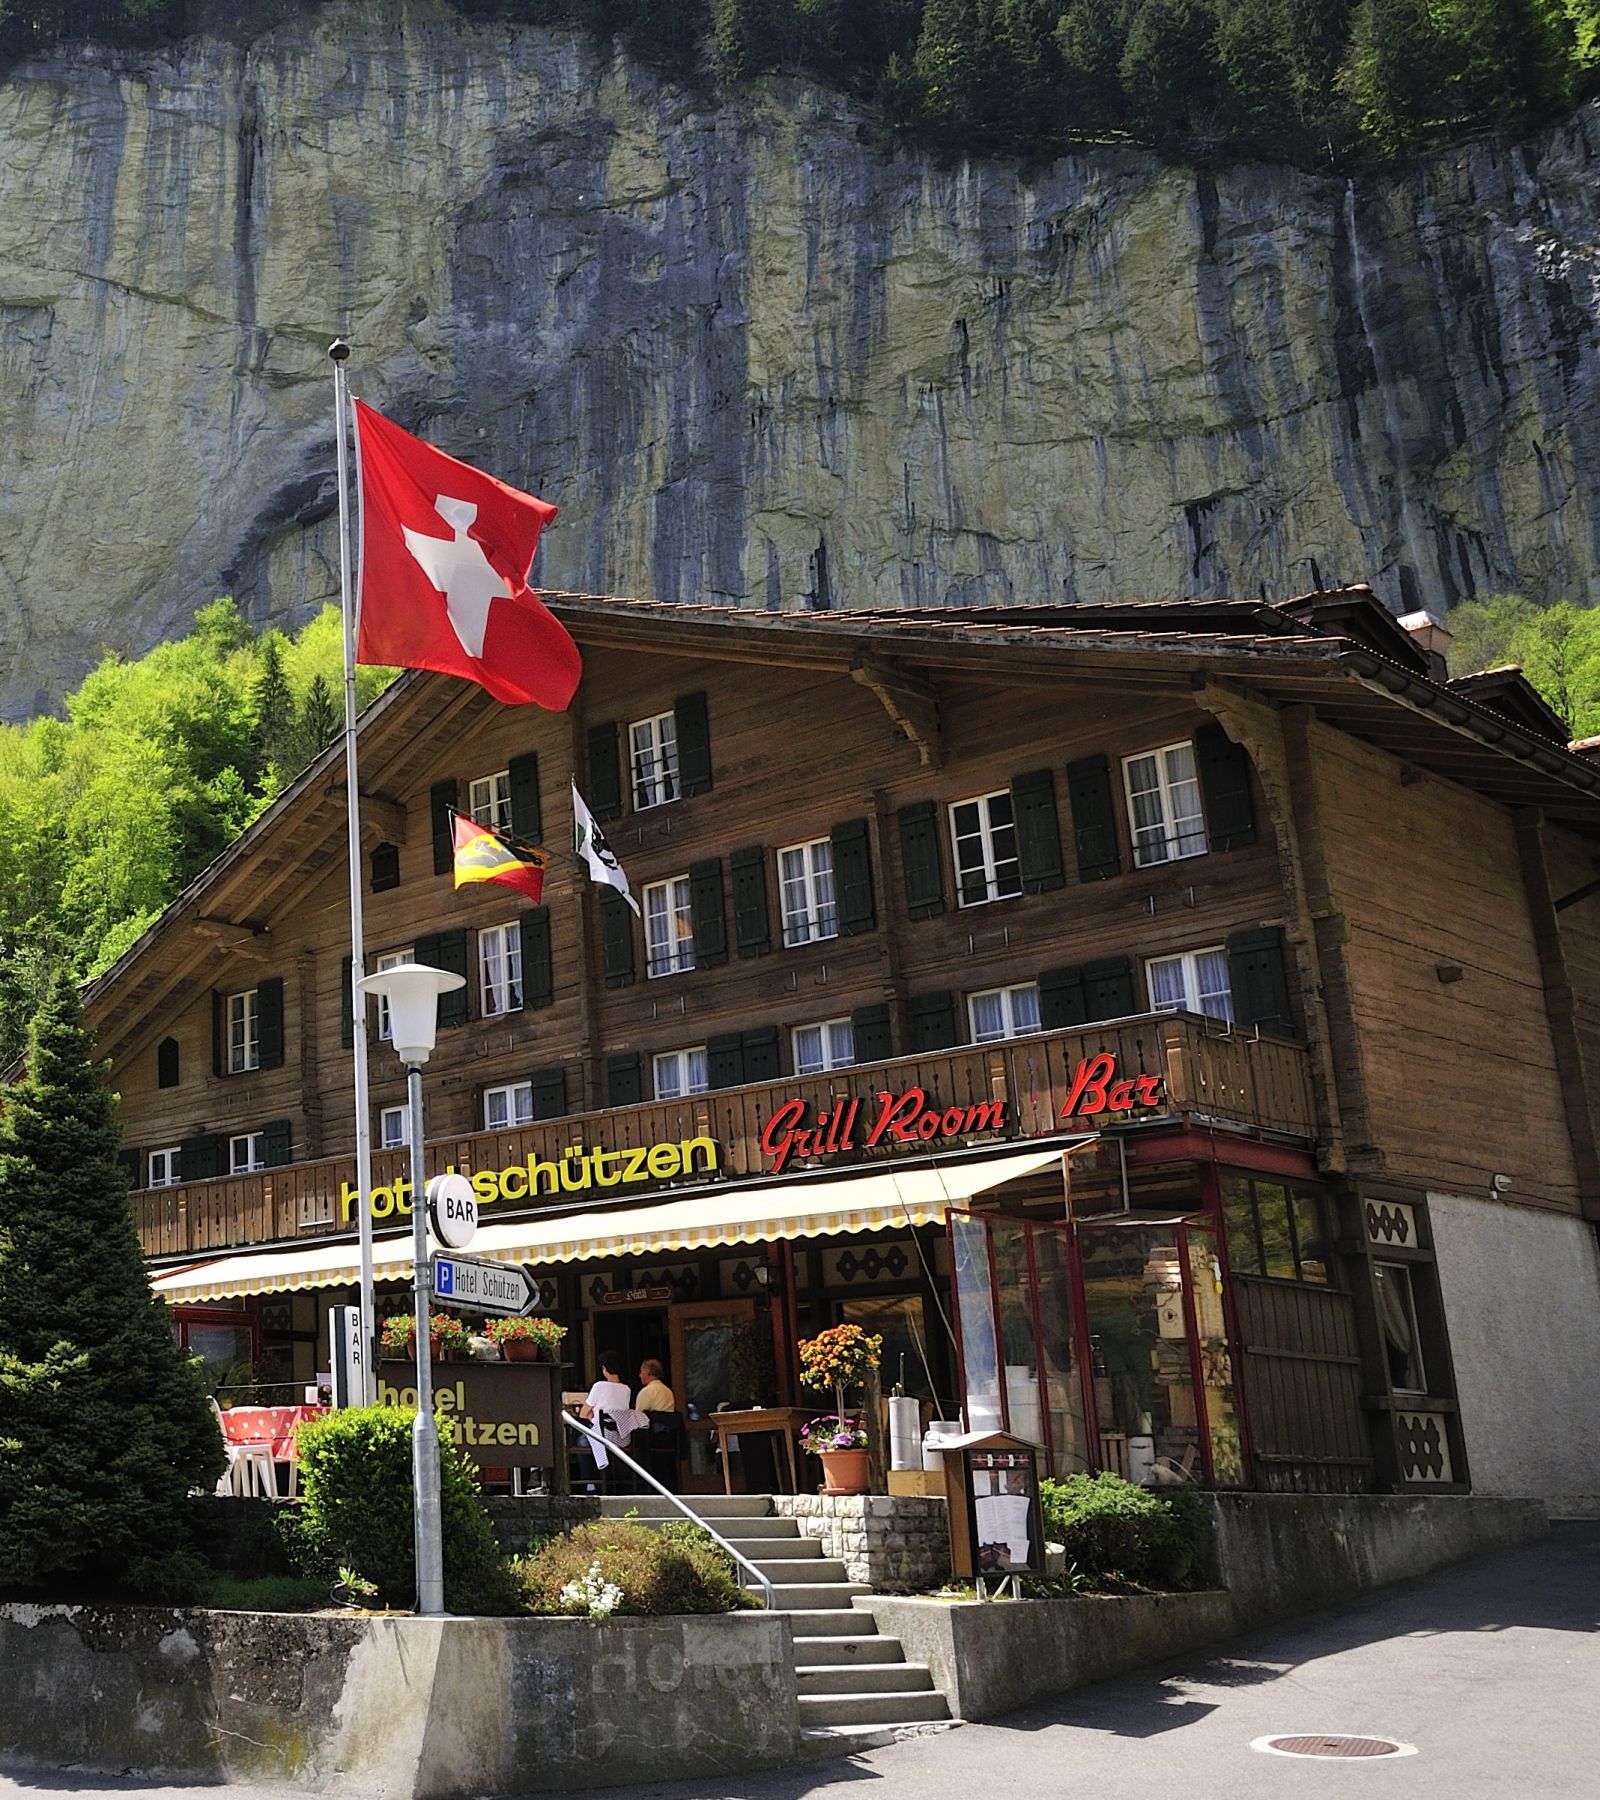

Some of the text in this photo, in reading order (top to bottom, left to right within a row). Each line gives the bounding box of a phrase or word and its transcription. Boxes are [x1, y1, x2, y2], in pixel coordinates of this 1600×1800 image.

[761, 1052, 1163, 1174] Grill Room Bar
[341, 1136, 718, 1222] hot schützen
[446, 1198, 475, 1222] BAR
[441, 1266, 520, 1301] P Hotel Schützen
[351, 1313, 361, 1365] BAR
[378, 1379, 465, 1411] hoel
